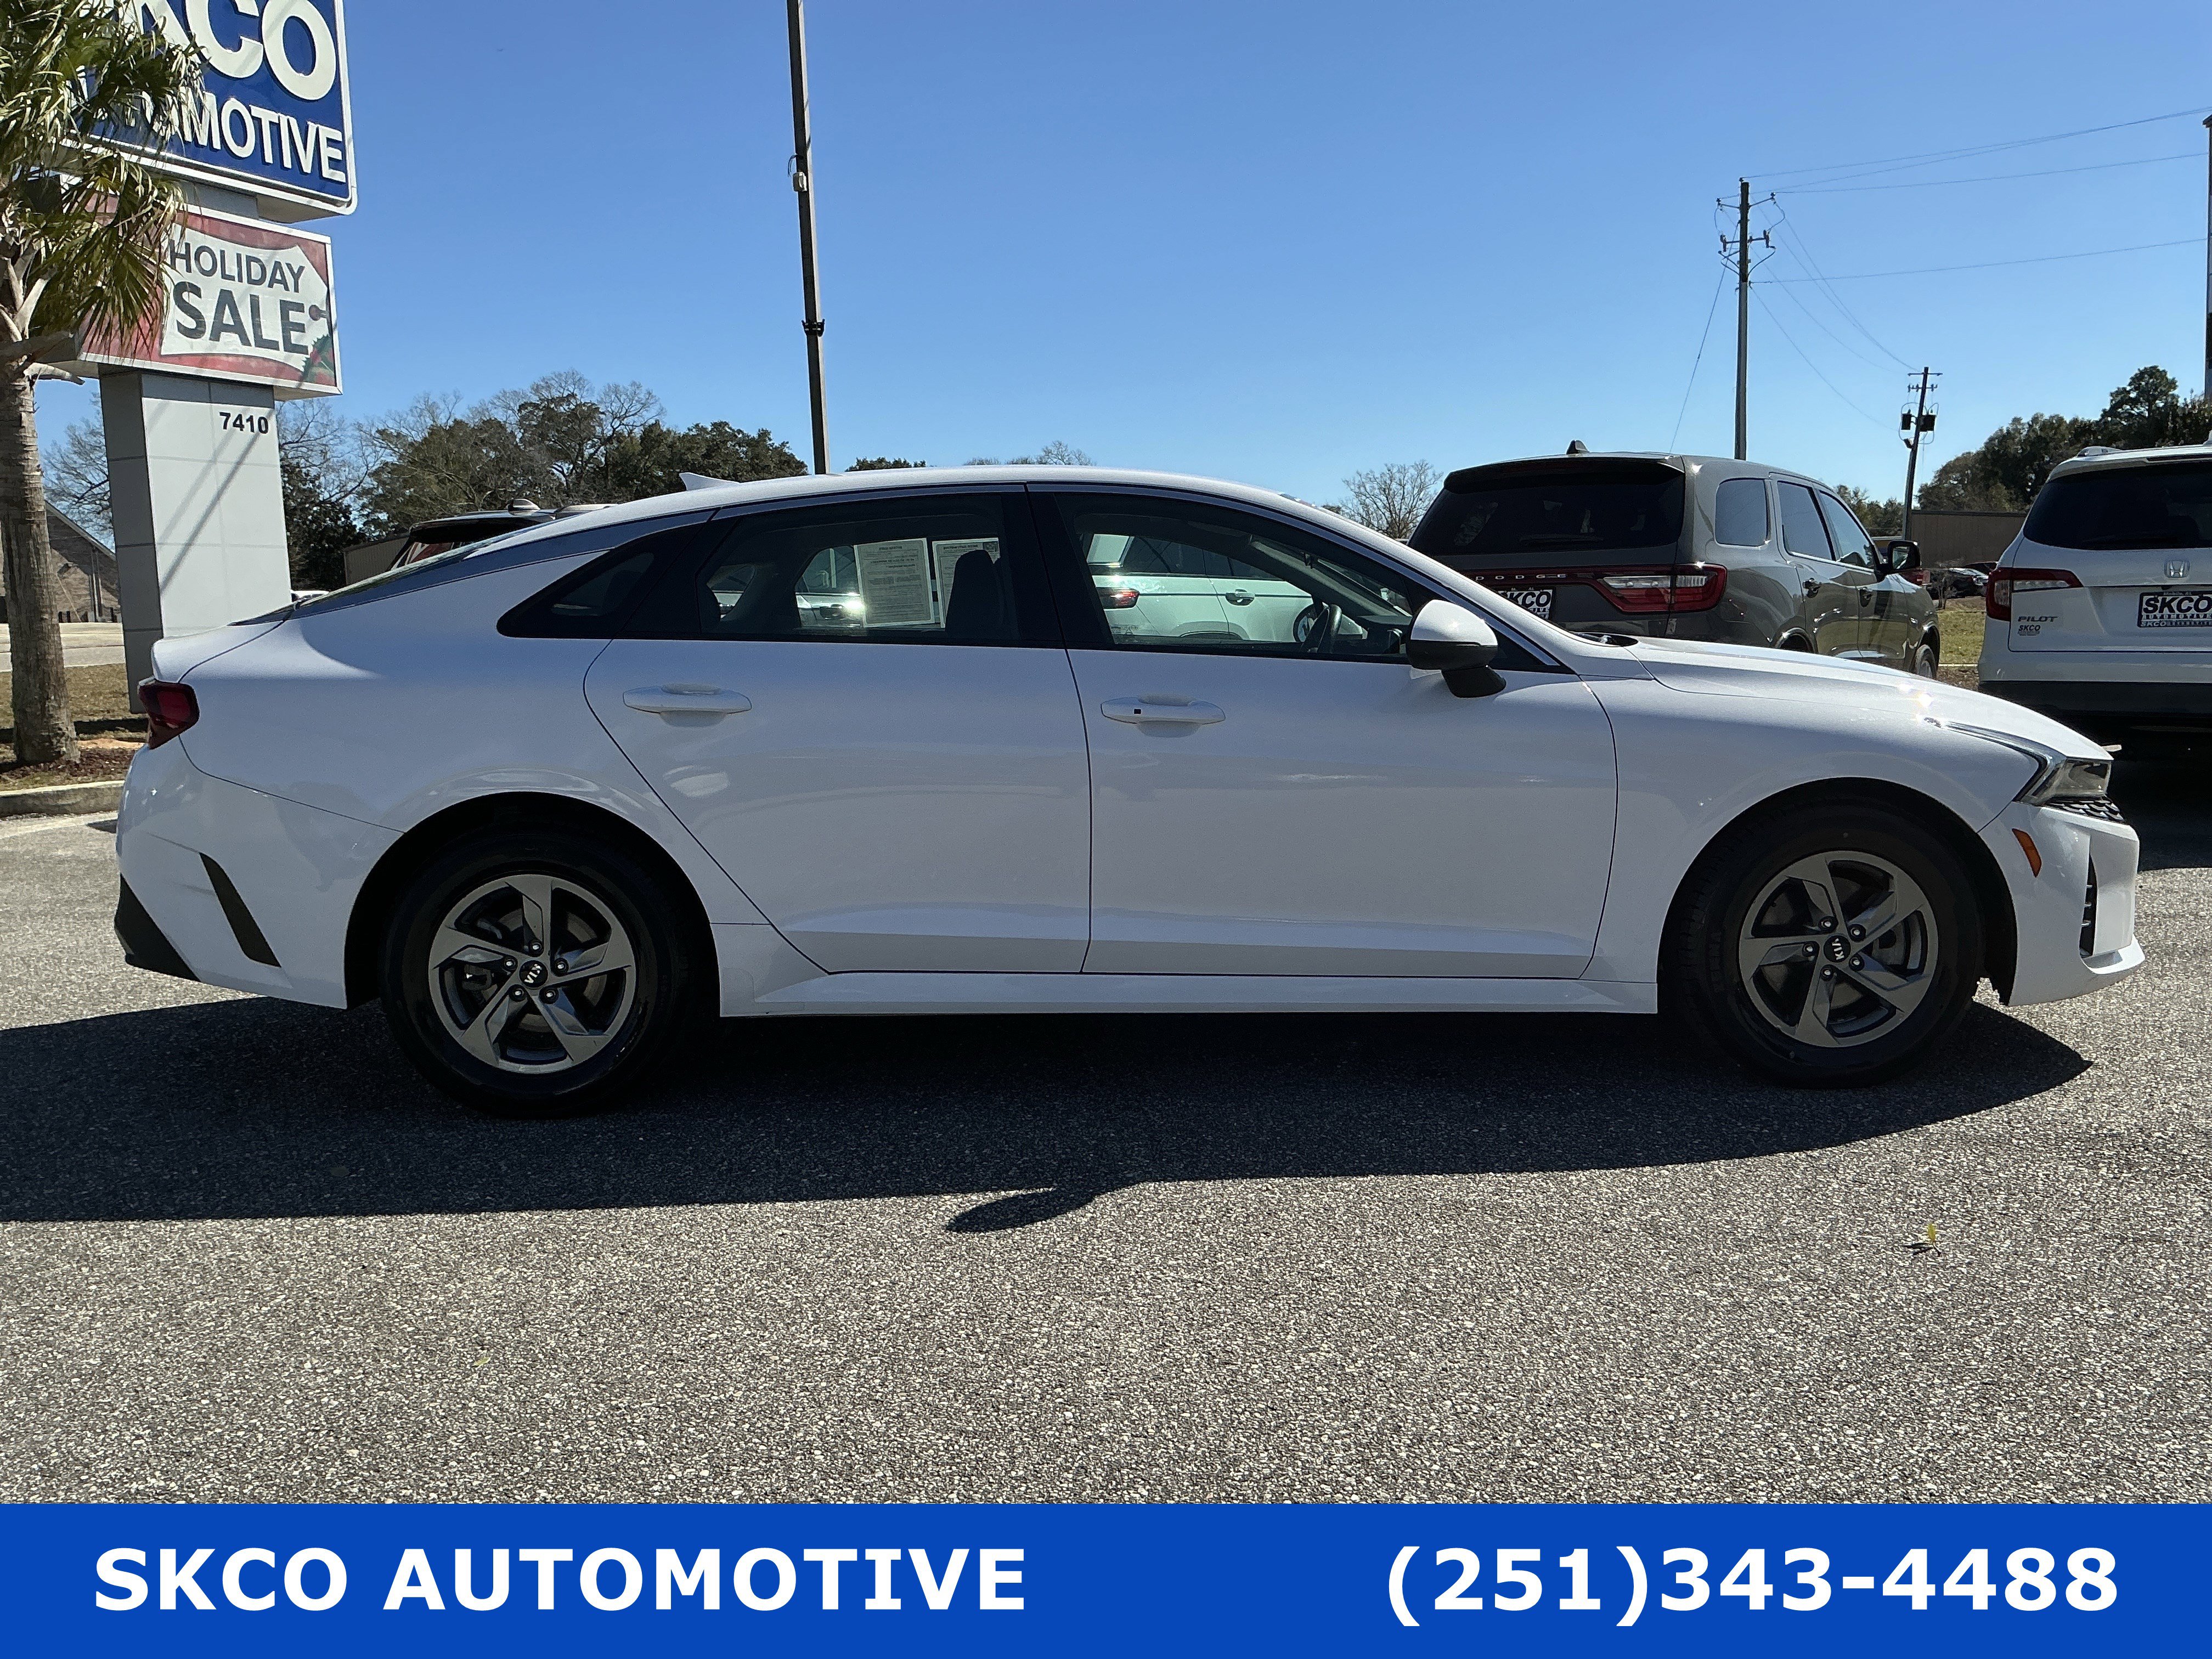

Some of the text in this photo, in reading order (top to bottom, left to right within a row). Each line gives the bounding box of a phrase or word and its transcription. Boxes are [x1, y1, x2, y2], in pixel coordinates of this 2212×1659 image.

[170, 240, 305, 293] HOLIDAY
[173, 281, 308, 354] SALE
[219, 412, 269, 434] 7410
[2143, 596, 2211, 614] SKCO
